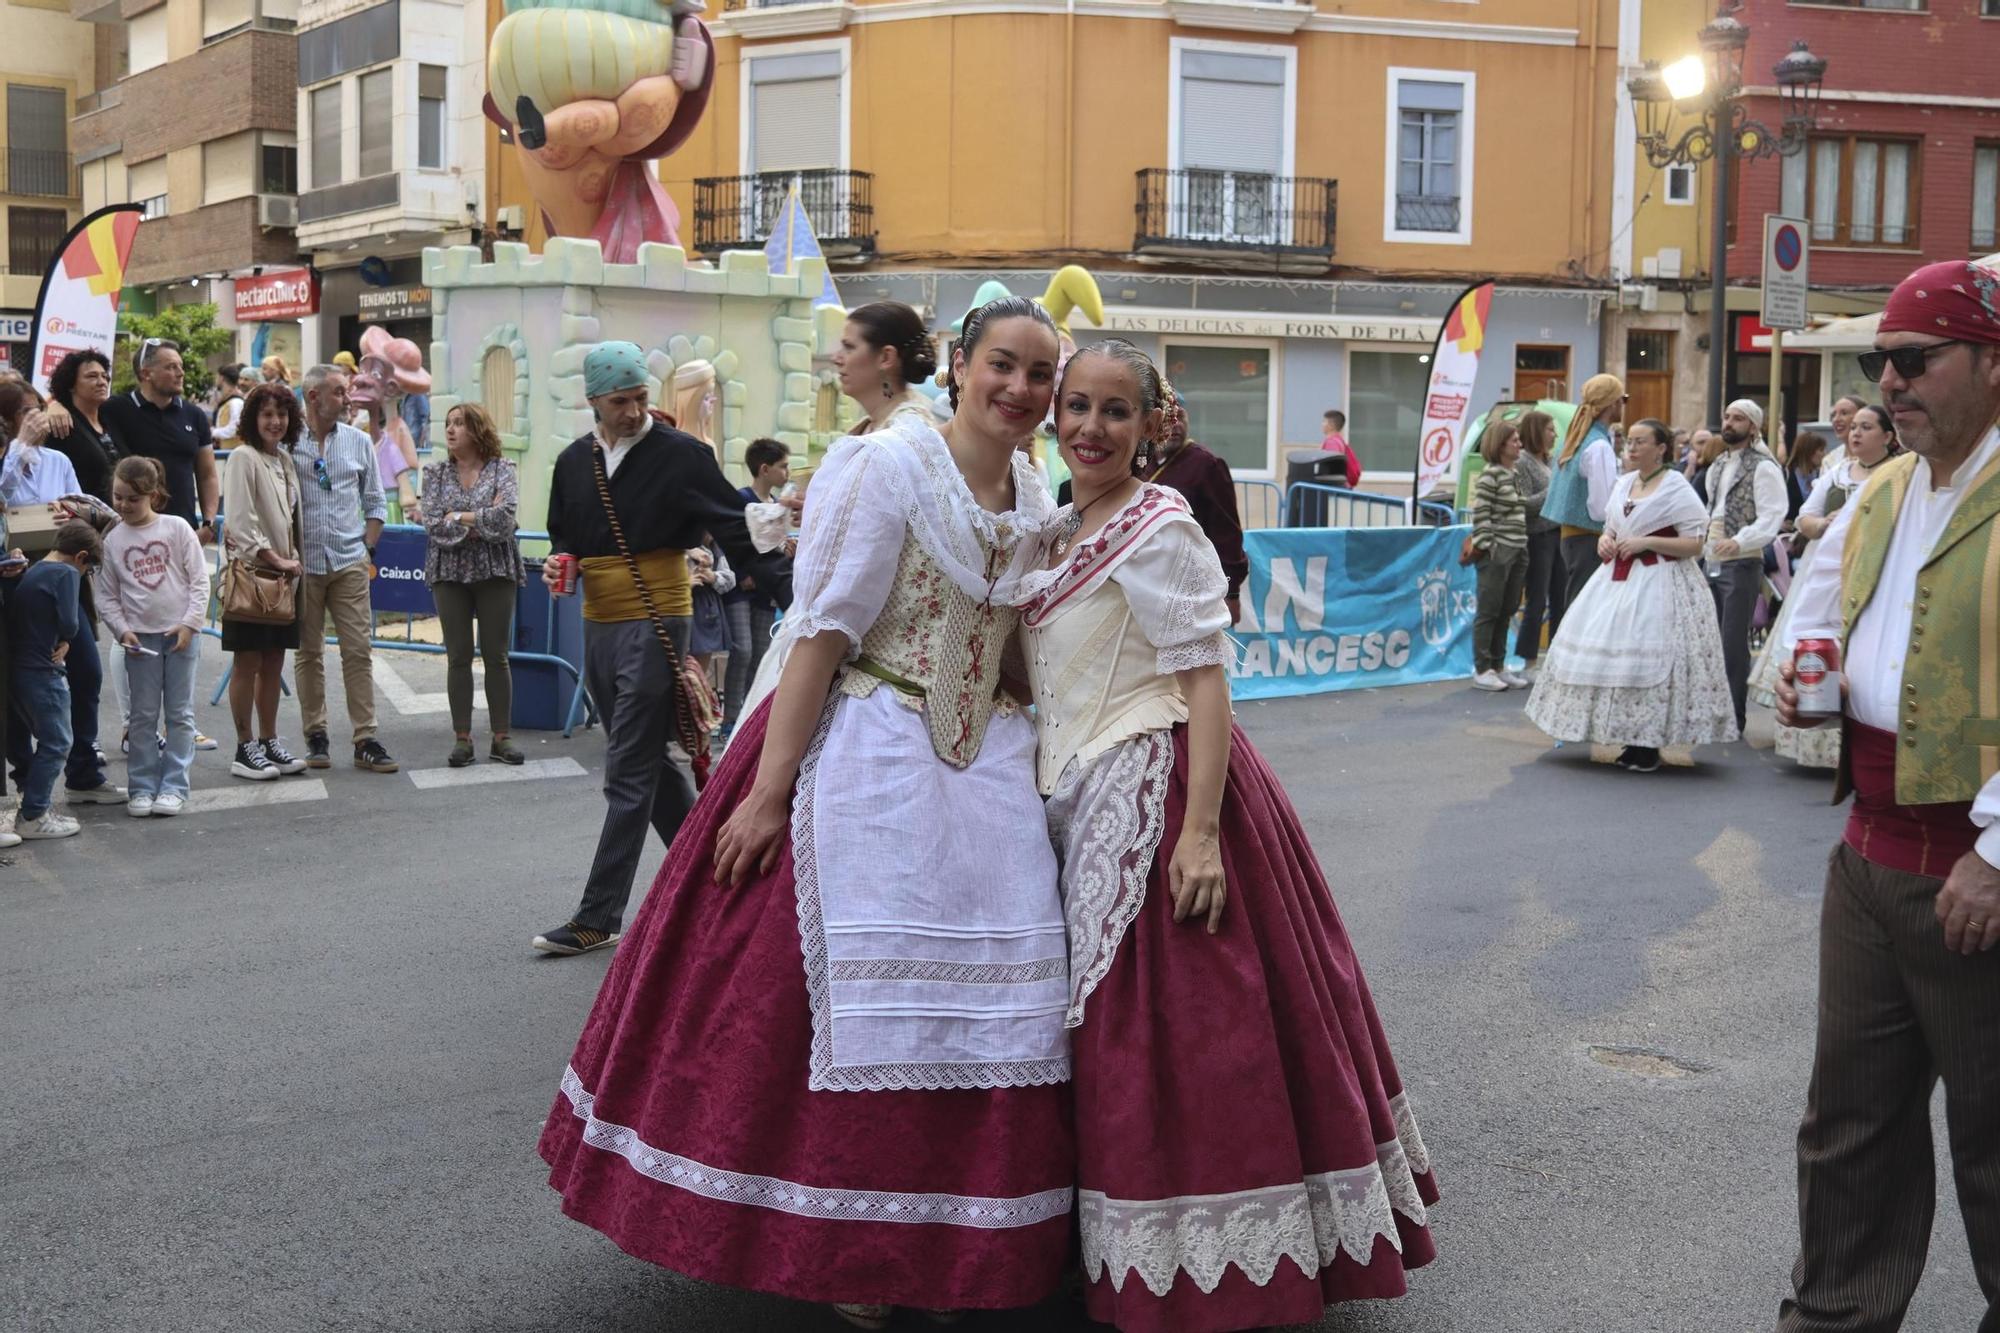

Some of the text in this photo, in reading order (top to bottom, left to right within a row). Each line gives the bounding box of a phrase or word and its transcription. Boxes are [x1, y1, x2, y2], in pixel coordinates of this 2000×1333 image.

[359, 291, 397, 308] TENEMOS
[398, 290, 408, 305] TU
[1111, 317, 1147, 330] LAS
[1158, 319, 1244, 334] DELICIAS
[1285, 323, 1339, 337] FORN
[1351, 326, 1377, 339] DE
[134, 555, 162, 568] MON
[133, 565, 167, 579] CHERI
[380, 566, 411, 580] Caixa
